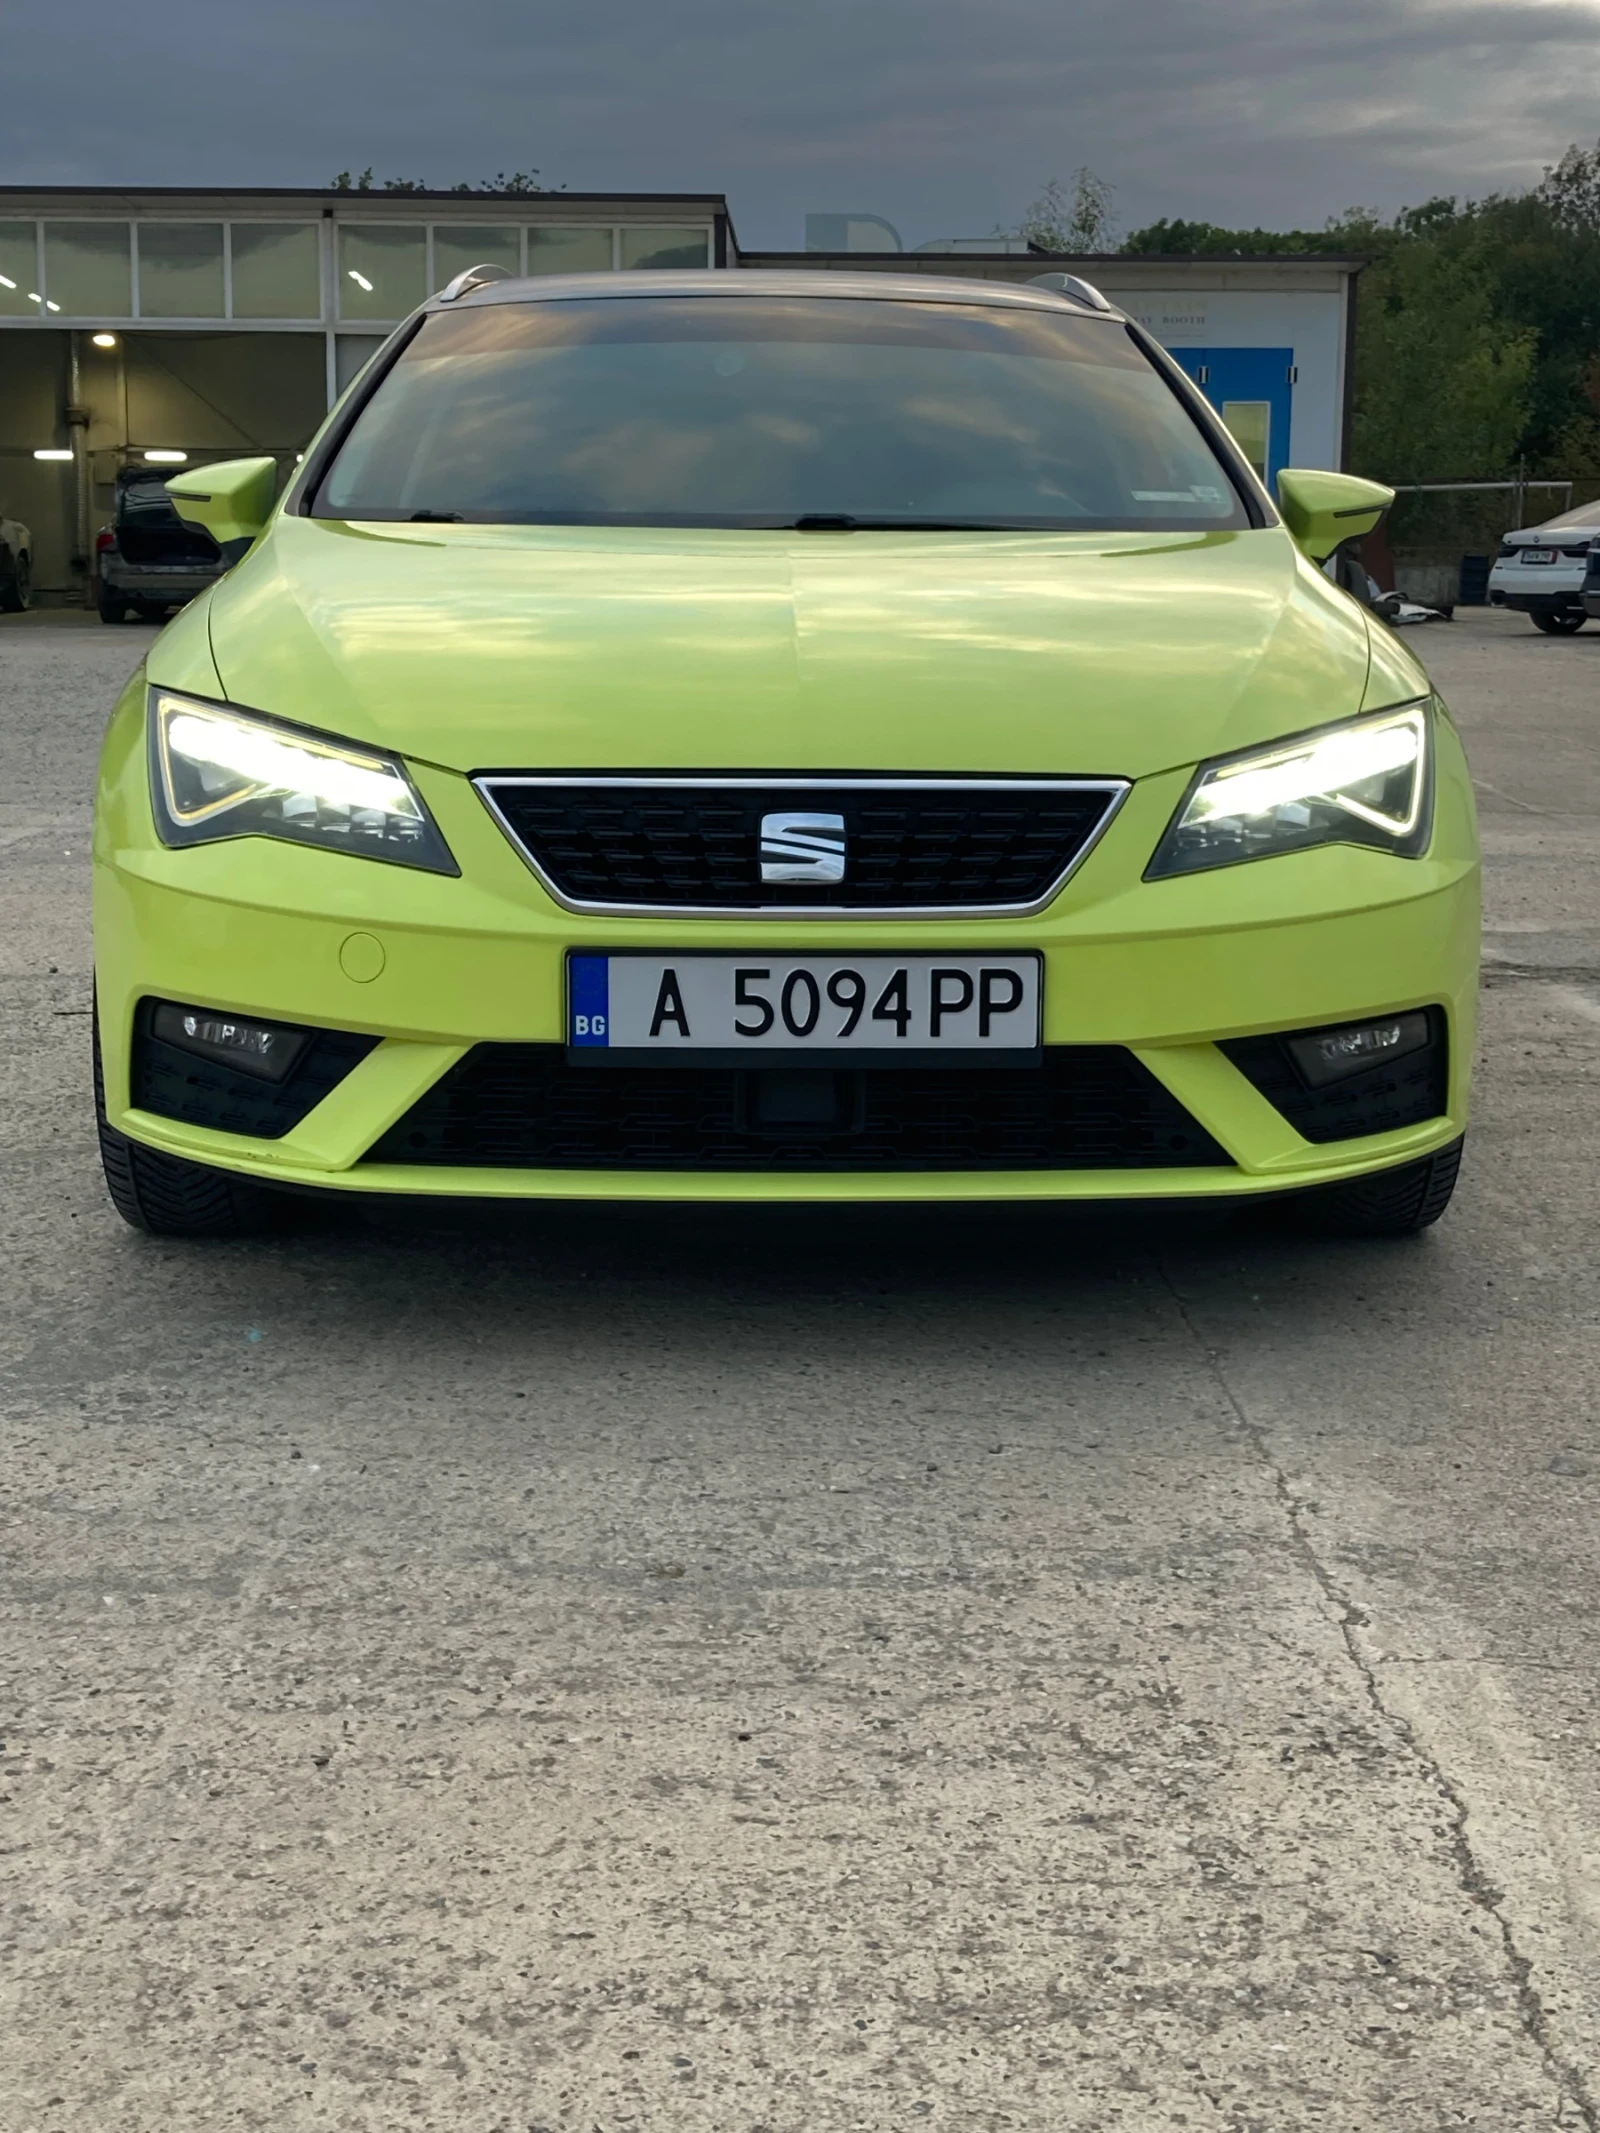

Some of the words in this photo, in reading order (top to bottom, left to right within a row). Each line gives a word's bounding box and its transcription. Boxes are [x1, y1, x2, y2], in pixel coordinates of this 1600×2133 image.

[1162, 316, 1206, 325] BOOTH
[649, 968, 691, 1038] A
[576, 1014, 606, 1036] BG
